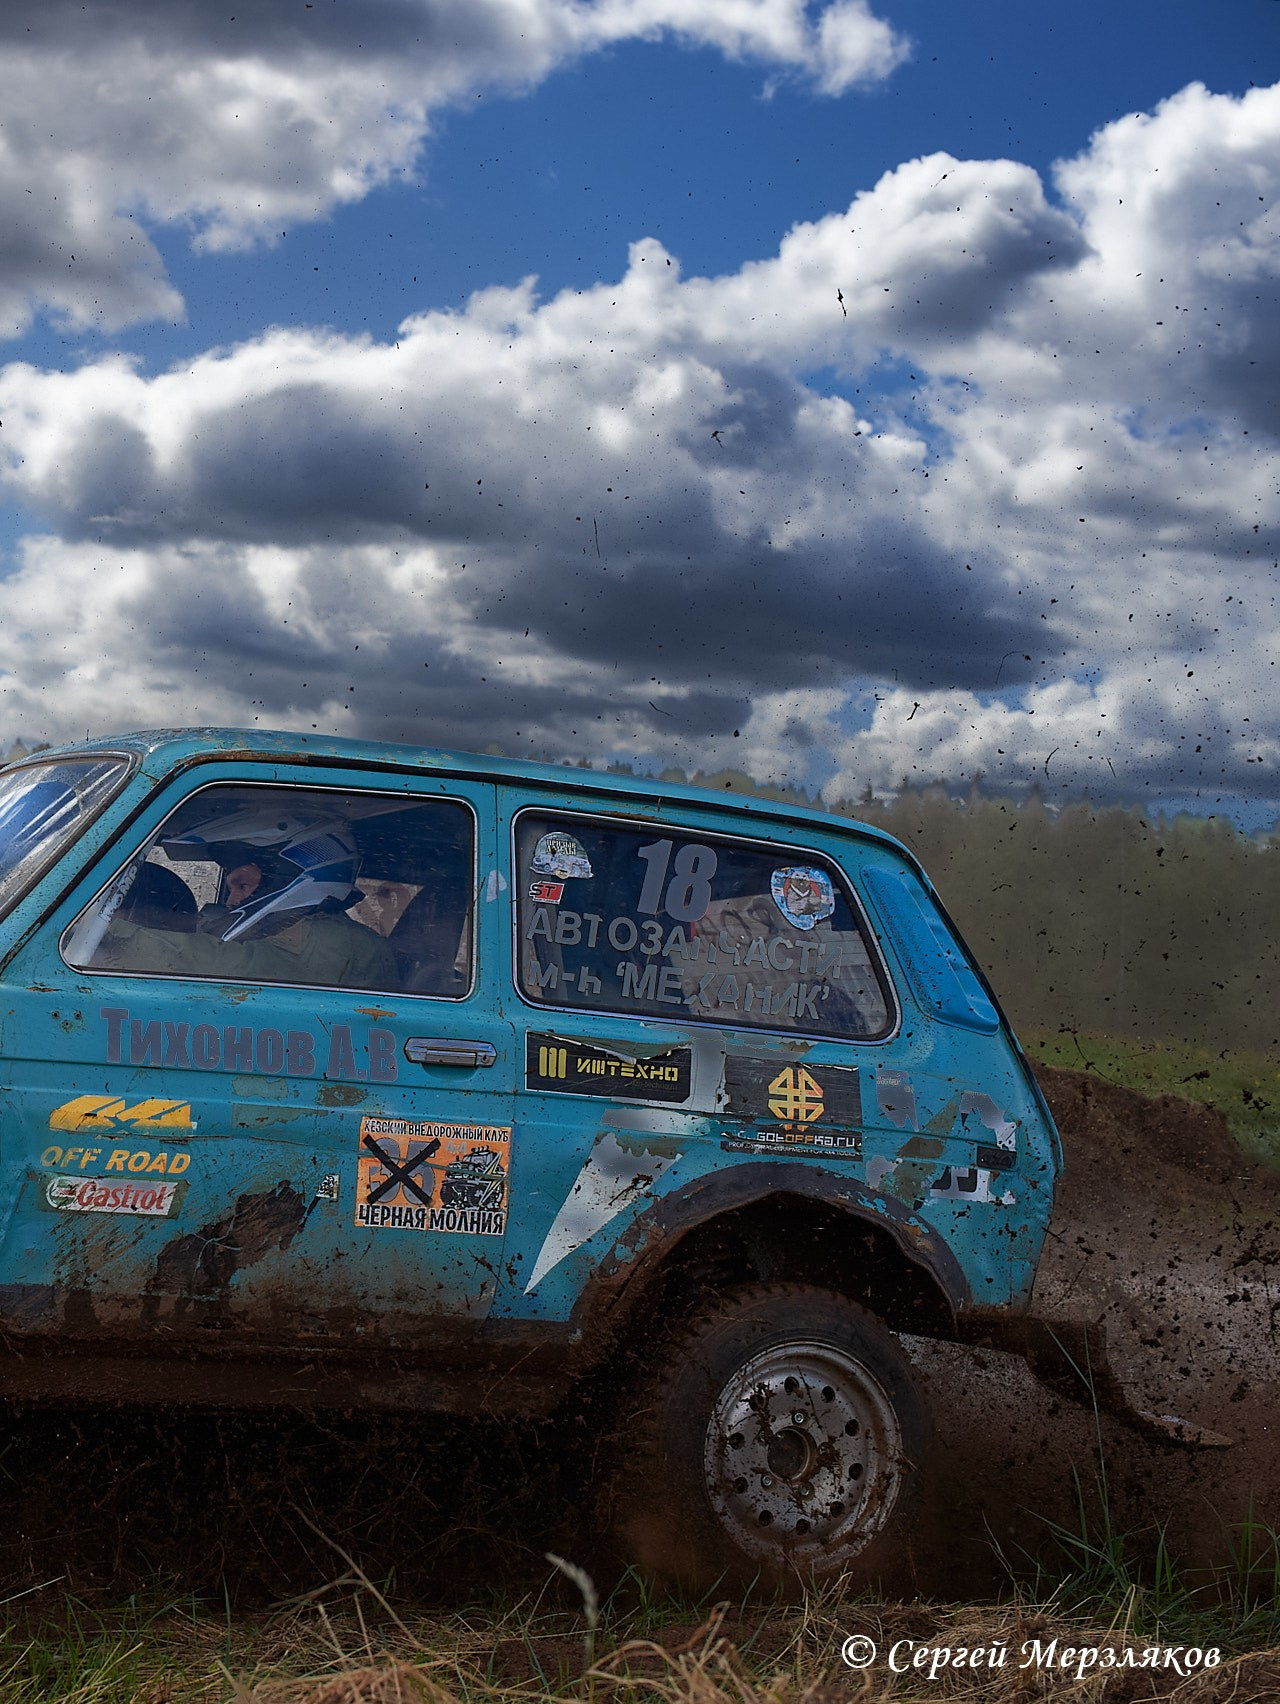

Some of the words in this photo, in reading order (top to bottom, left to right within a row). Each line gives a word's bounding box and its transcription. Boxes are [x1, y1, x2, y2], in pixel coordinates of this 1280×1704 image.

[530, 884, 555, 898] ST
[637, 839, 718, 922] 18
[408, 1123, 483, 1141] ВНЕДОРОЖНЫЙ
[484, 1129, 509, 1143] КЛУБ
[40, 1145, 102, 1170] OFF
[104, 1148, 191, 1174] ROAD
[77, 1181, 167, 1211] Castrol
[359, 1205, 425, 1228] ЧЕРНАЯ
[429, 1209, 504, 1235] МОЛНИЯ
